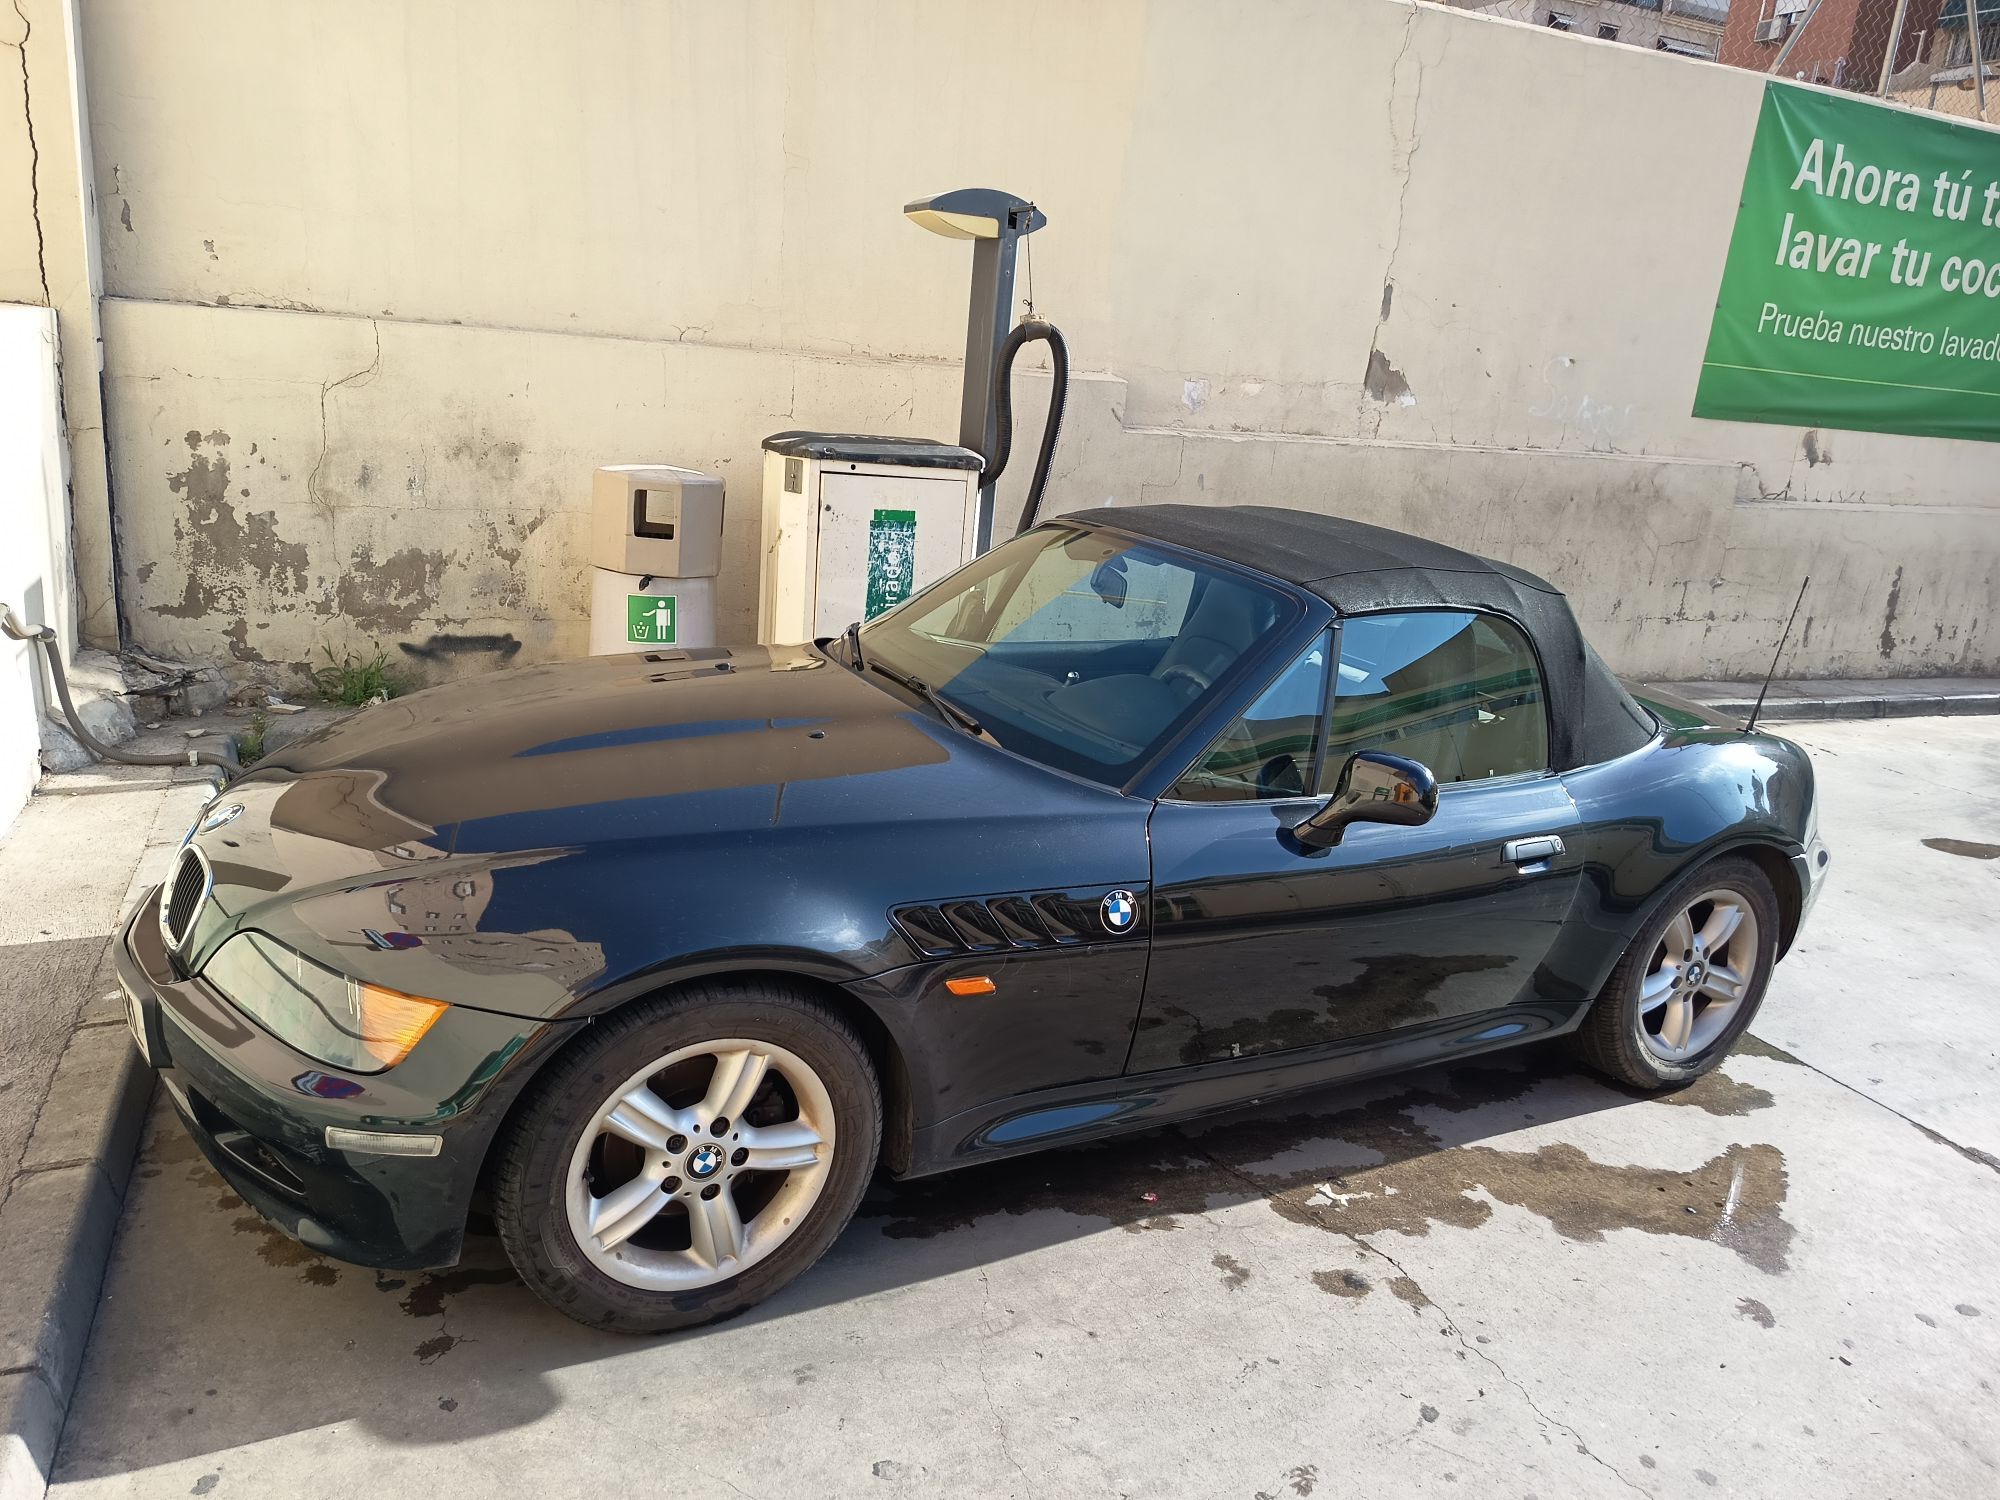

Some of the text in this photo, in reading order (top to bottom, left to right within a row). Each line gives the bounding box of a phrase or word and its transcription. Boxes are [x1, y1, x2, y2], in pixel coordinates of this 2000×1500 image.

[1790, 138, 1920, 213] Ahora
[1932, 169, 1973, 221] tú
[1775, 213, 1882, 279] lavar
[1890, 238, 1932, 288] tu
[1758, 302, 2000, 362] Prueba nuestro lavad
